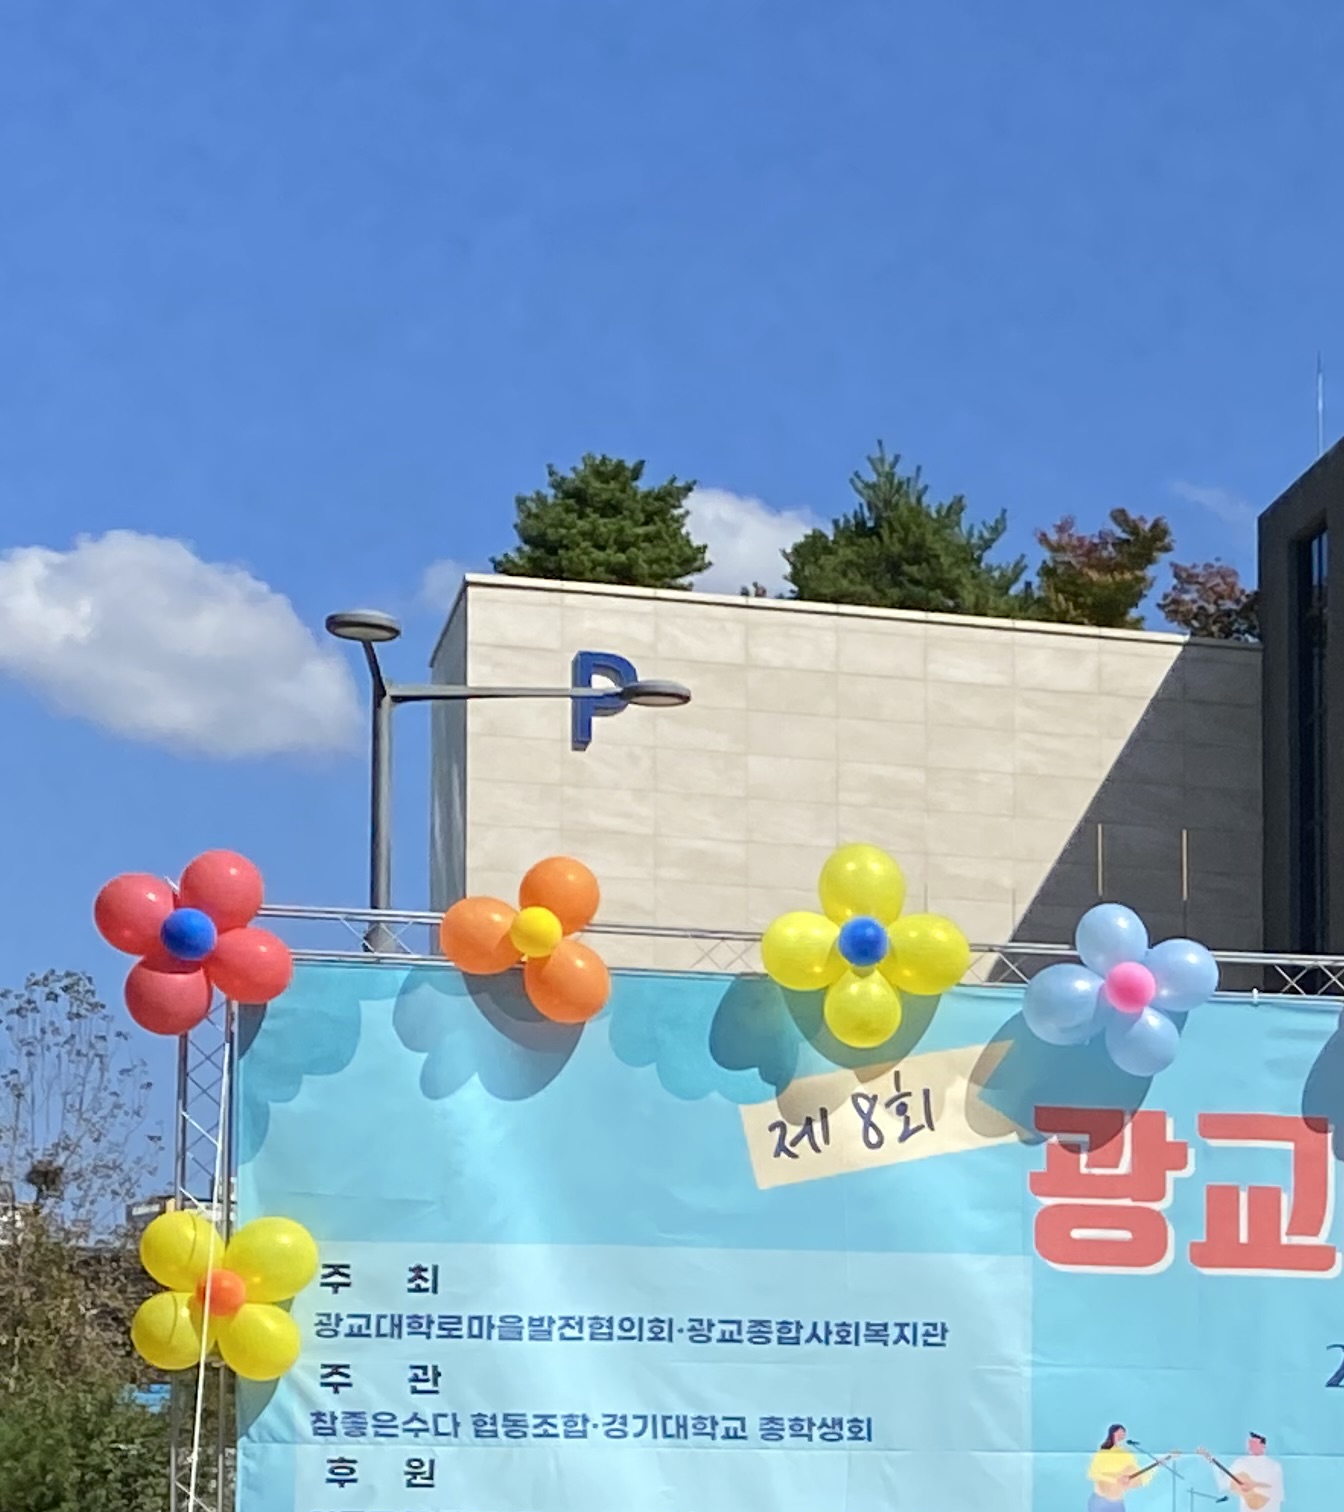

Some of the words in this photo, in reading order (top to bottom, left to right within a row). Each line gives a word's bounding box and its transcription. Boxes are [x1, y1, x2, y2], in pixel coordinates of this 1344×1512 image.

[571, 650, 638, 751] P
[310, 1410, 461, 1439] 참좋은수다
[759, 1415, 873, 1443] 총학생회
